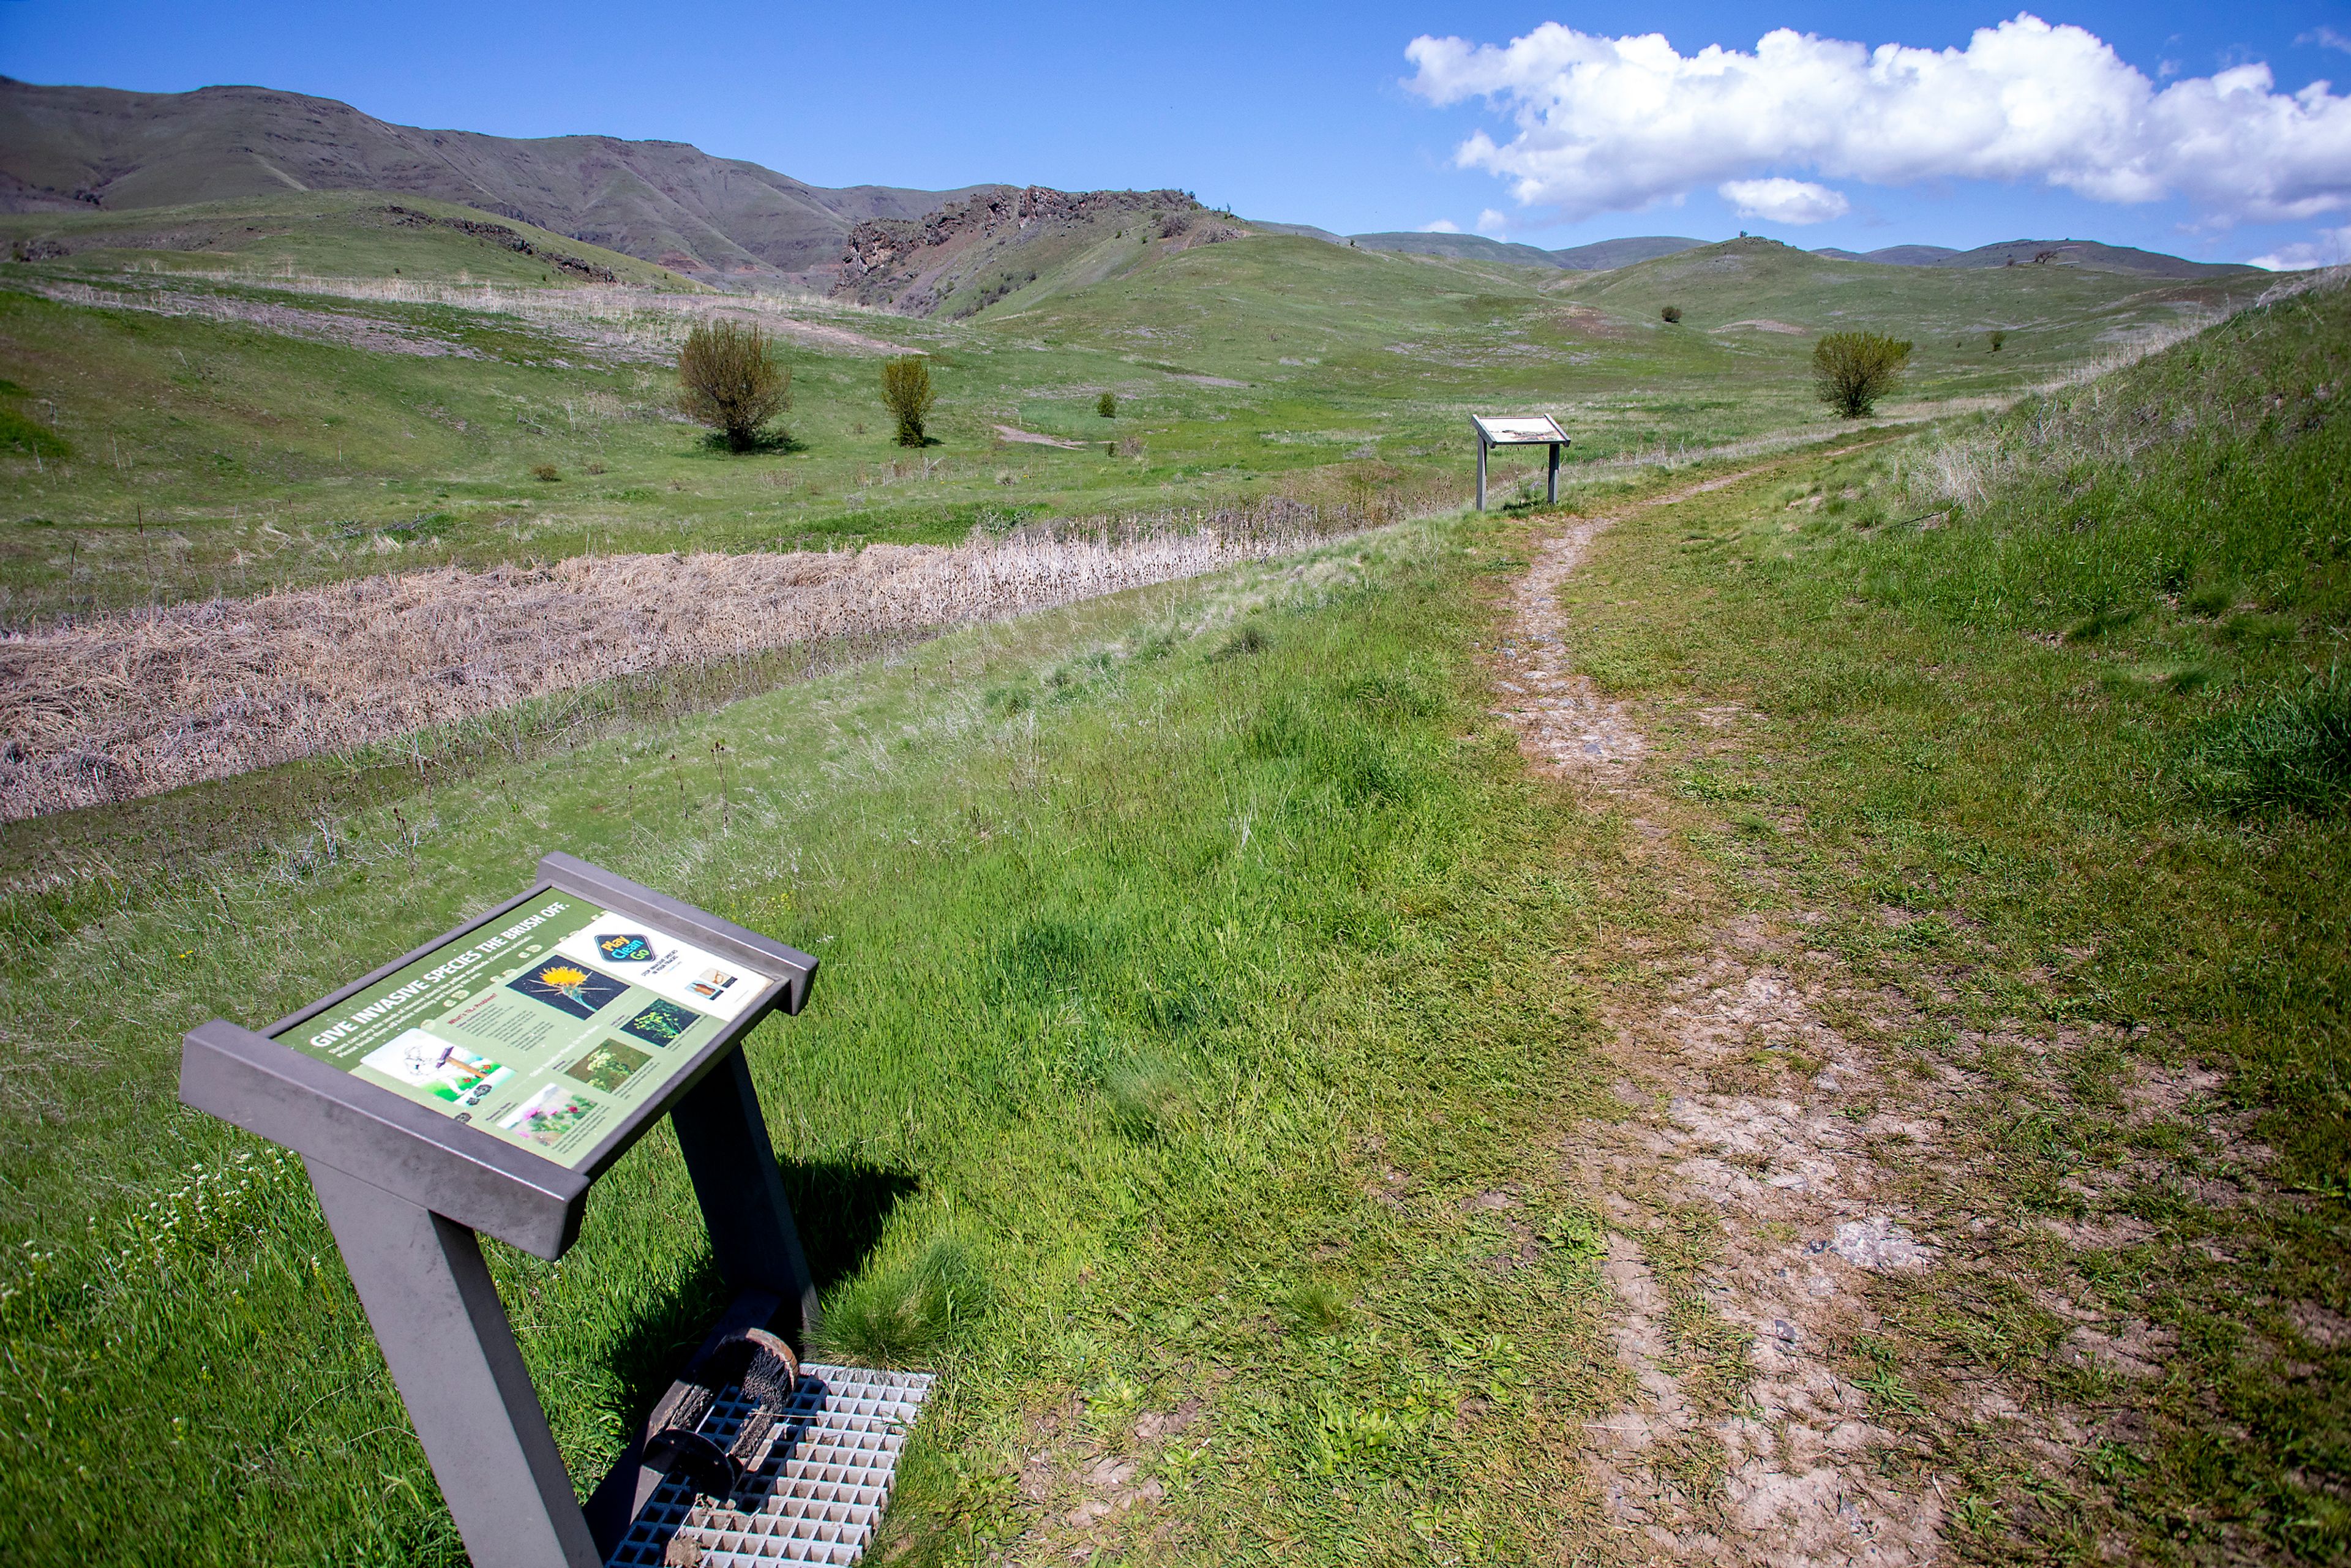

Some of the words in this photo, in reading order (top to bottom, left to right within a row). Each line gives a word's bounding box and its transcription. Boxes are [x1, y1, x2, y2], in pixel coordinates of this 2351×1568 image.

[601, 936, 629, 951] Play
[611, 940, 644, 959] Clean
[630, 949, 650, 959] Go
[310, 1021, 359, 1047] GIVE
[350, 980, 430, 1024] INVASIVE
[423, 950, 482, 983] SPECIES
[474, 937, 508, 953] THE
[500, 915, 546, 940] BRUSH
[540, 902, 570, 917] OFF.
[358, 1028, 374, 1038] carry
[448, 973, 467, 985] yellow
[372, 1027, 389, 1037] them
[413, 1000, 437, 1013] entering
[443, 984, 463, 995] leaving
